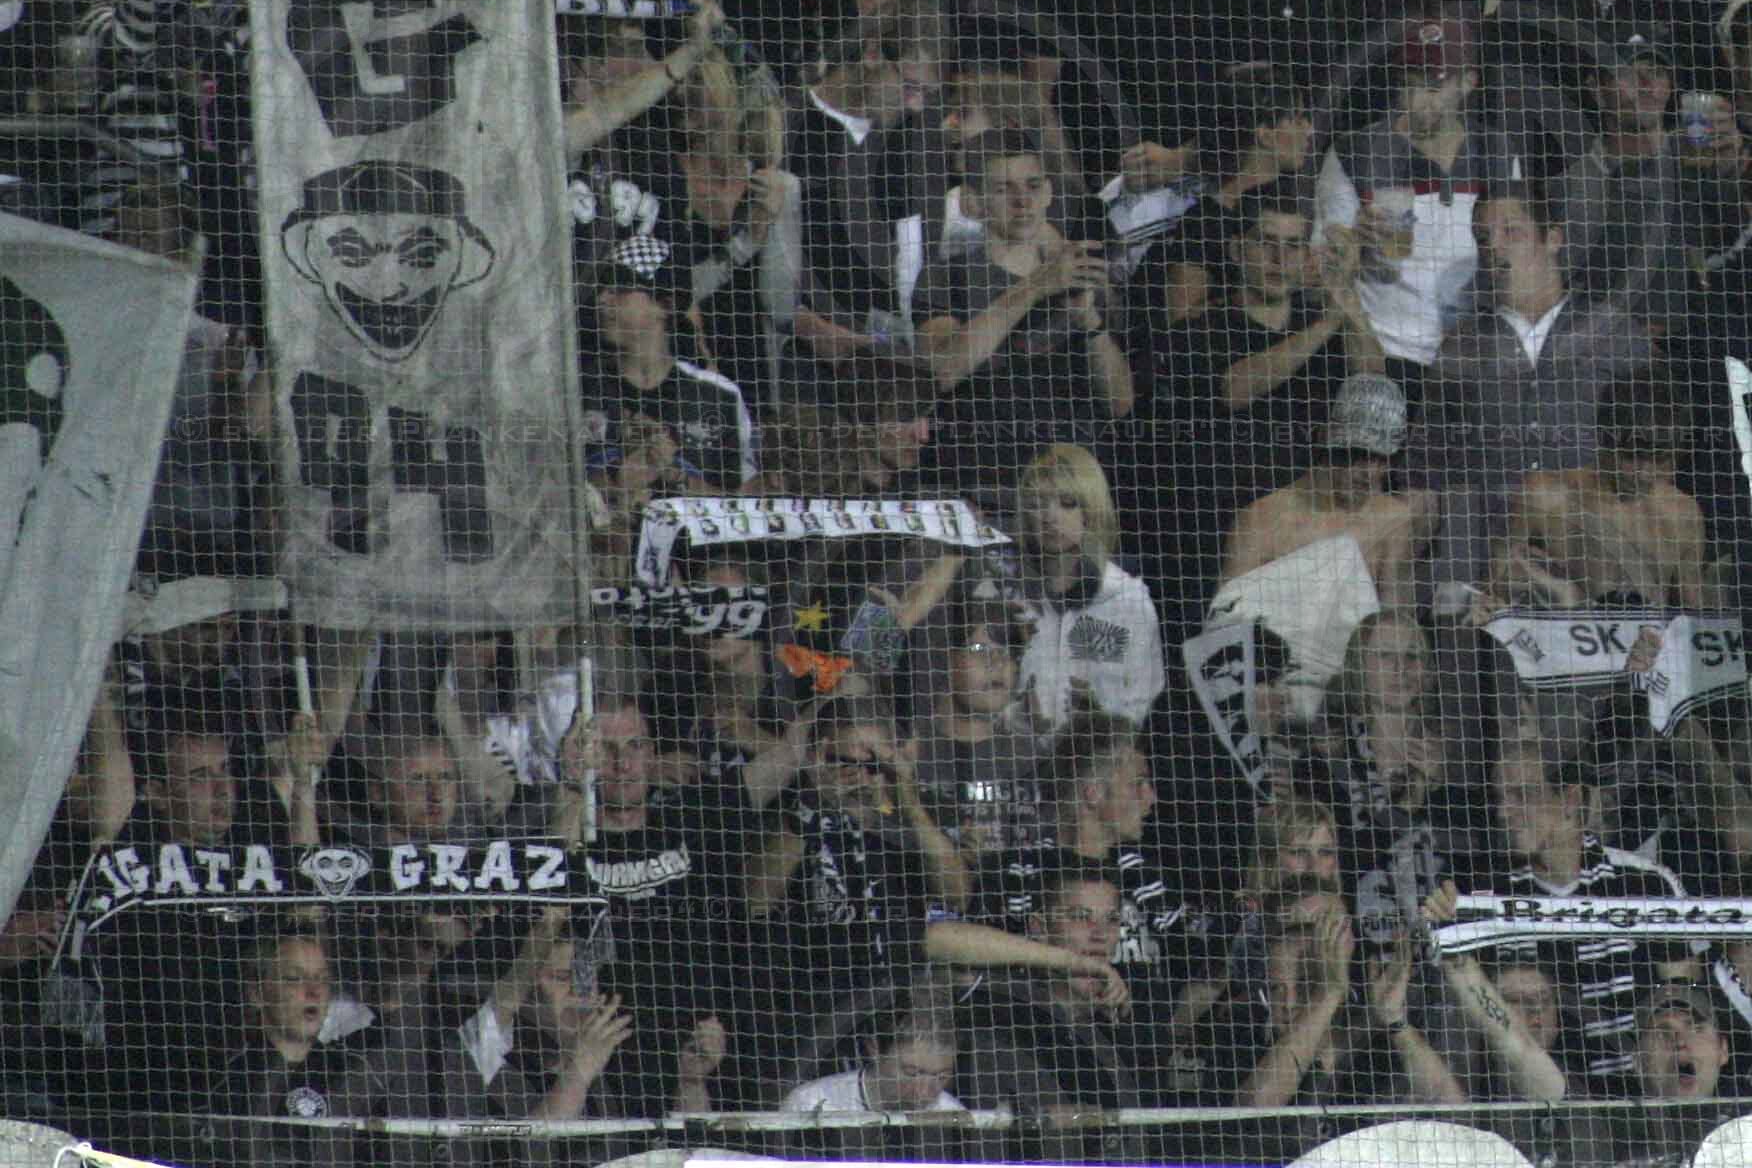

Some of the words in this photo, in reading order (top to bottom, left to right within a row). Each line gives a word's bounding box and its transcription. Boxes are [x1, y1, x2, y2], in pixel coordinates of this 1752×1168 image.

[1569, 623, 1629, 657] SK
[94, 842, 283, 899] IGATA
[390, 841, 567, 894] GRAZ
